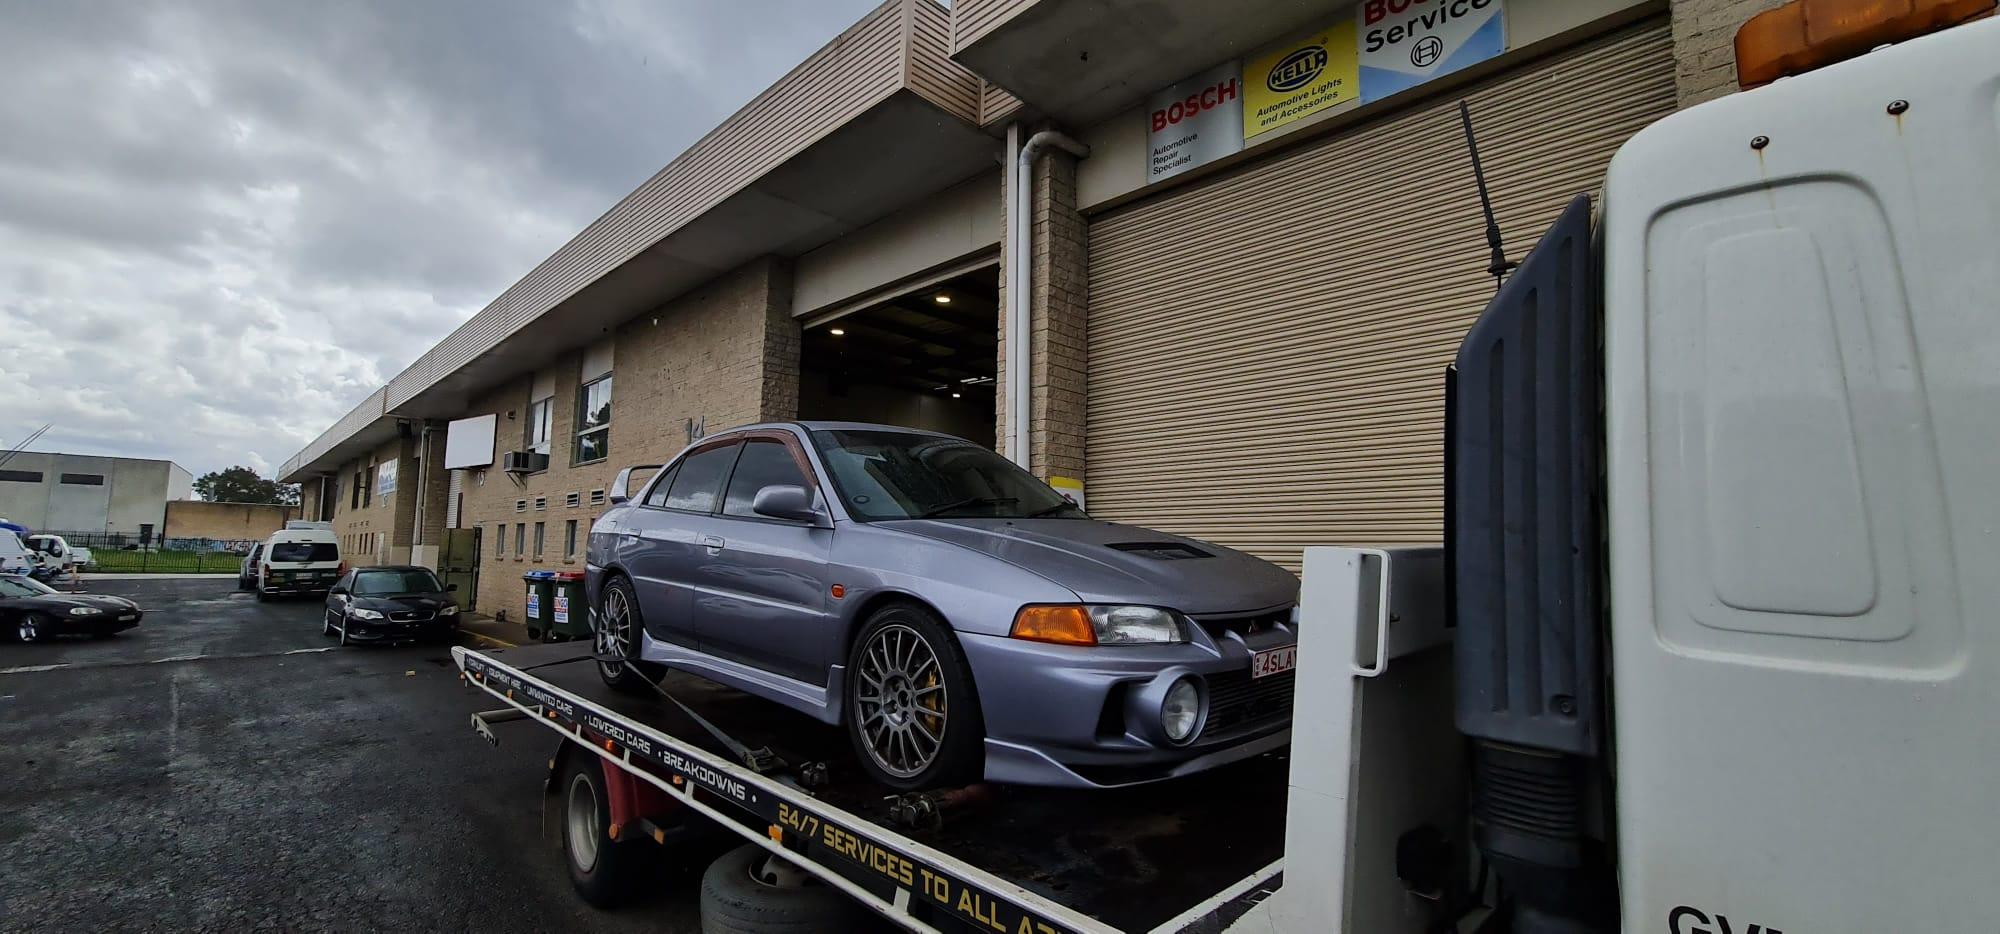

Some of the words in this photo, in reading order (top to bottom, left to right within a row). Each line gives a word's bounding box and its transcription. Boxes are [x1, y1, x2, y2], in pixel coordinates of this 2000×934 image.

[1271, 48, 1328, 85] HELLA
[1151, 78, 1236, 133] BOSCH
[1256, 91, 1310, 118] Automotive
[1311, 78, 1343, 96] Lights
[1260, 113, 1281, 127] and
[1280, 91, 1339, 118] Accessories
[1153, 133, 1198, 157] Automotive
[1153, 151, 1179, 166] Repair
[1153, 155, 1192, 175] Specialist
[526, 685, 556, 707] UNWANTED
[556, 700, 573, 716] CARS
[588, 714, 625, 742] LOWERED
[626, 732, 651, 755] CARS
[663, 750, 746, 801] BREAKDOWNS
[778, 803, 819, 838] 24/7
[823, 823, 914, 887] SERVICES
[920, 868, 950, 904] TO
[957, 887, 1007, 933] ALL
